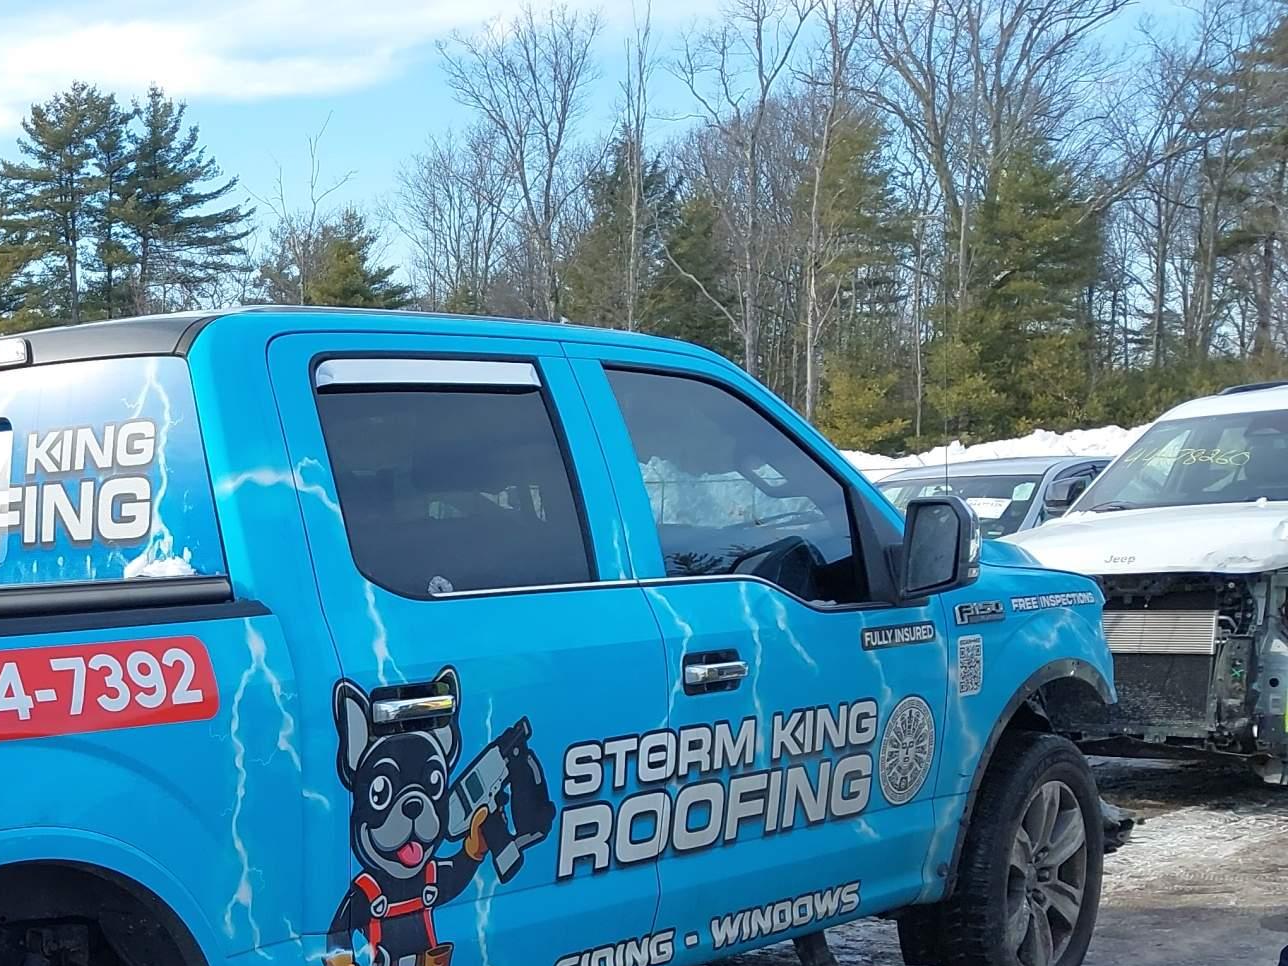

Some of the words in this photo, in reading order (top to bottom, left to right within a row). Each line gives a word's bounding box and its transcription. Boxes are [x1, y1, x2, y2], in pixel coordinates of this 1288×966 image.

[25, 420, 156, 476] KING
[1103, 554, 1136, 565] Jeep
[1011, 596, 1039, 612] FREE
[1040, 592, 1095, 609] INSPECTIONS
[864, 628, 894, 647] FULLY
[894, 624, 934, 643] INSURED
[563, 715, 756, 798] STORM
[770, 699, 879, 763] KING
[557, 753, 874, 879] ROOFING
[711, 880, 861, 948] WINDOWS
